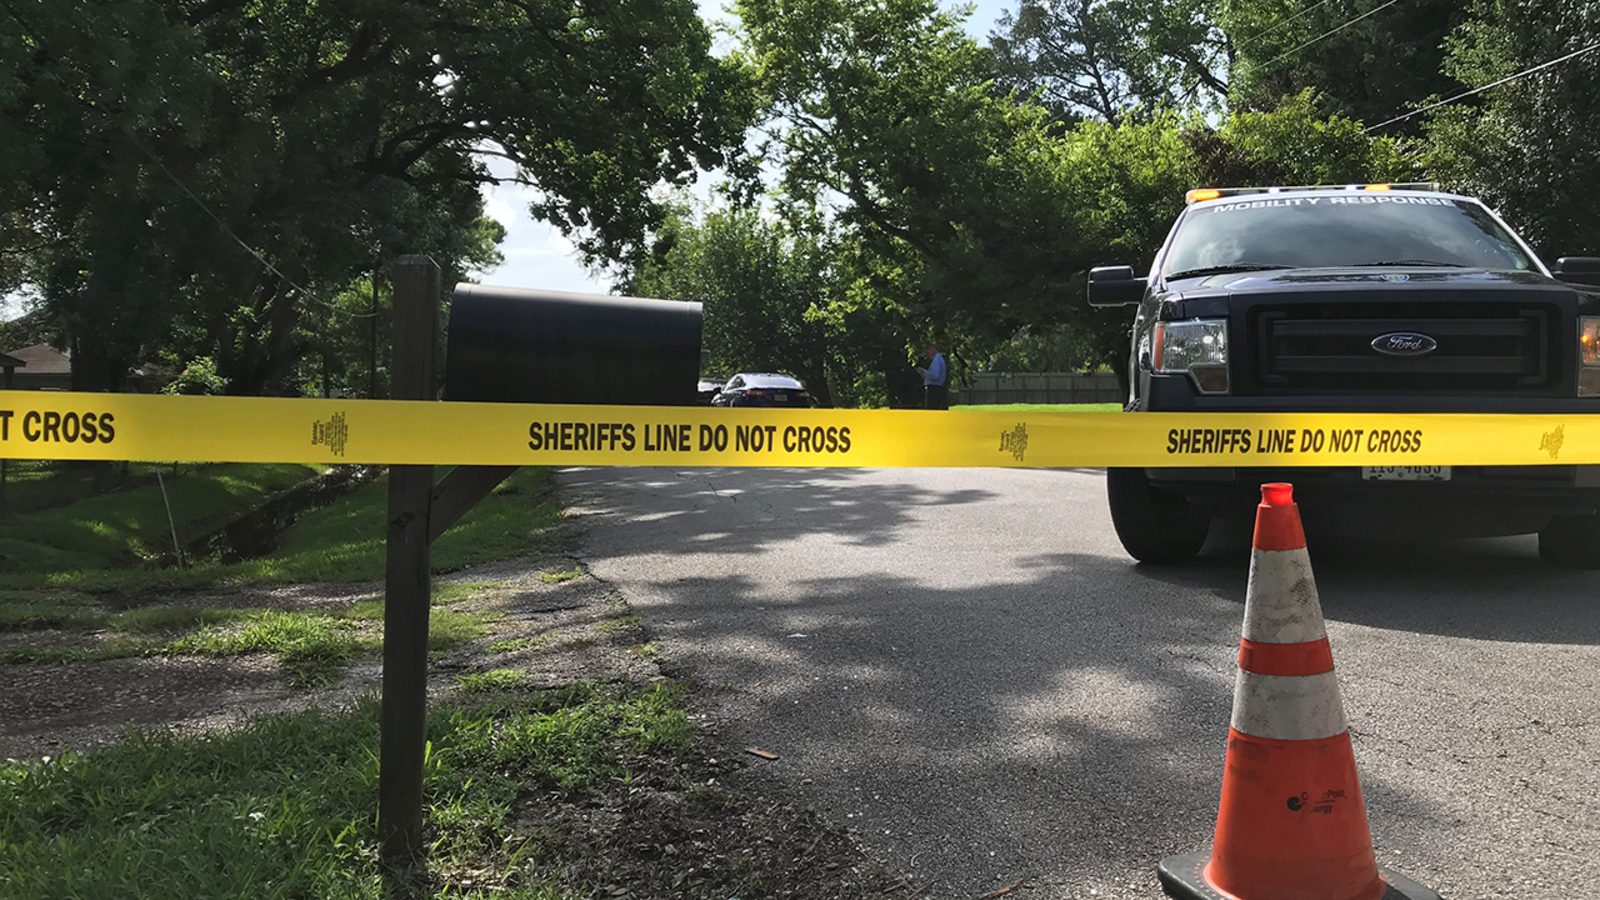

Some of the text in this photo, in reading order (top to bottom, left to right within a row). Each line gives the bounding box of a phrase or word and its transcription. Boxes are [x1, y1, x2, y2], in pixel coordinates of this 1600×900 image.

[1213, 196, 1456, 213] MOBILITY RESPONSE
[1387, 336, 1422, 350] Ford
[22, 410, 115, 444] CROSS
[528, 421, 851, 453] SHERIFFS LINE DO NOT CROSS
[1166, 429, 1422, 454] SHERIFFS LINE DO NOT CROSS
